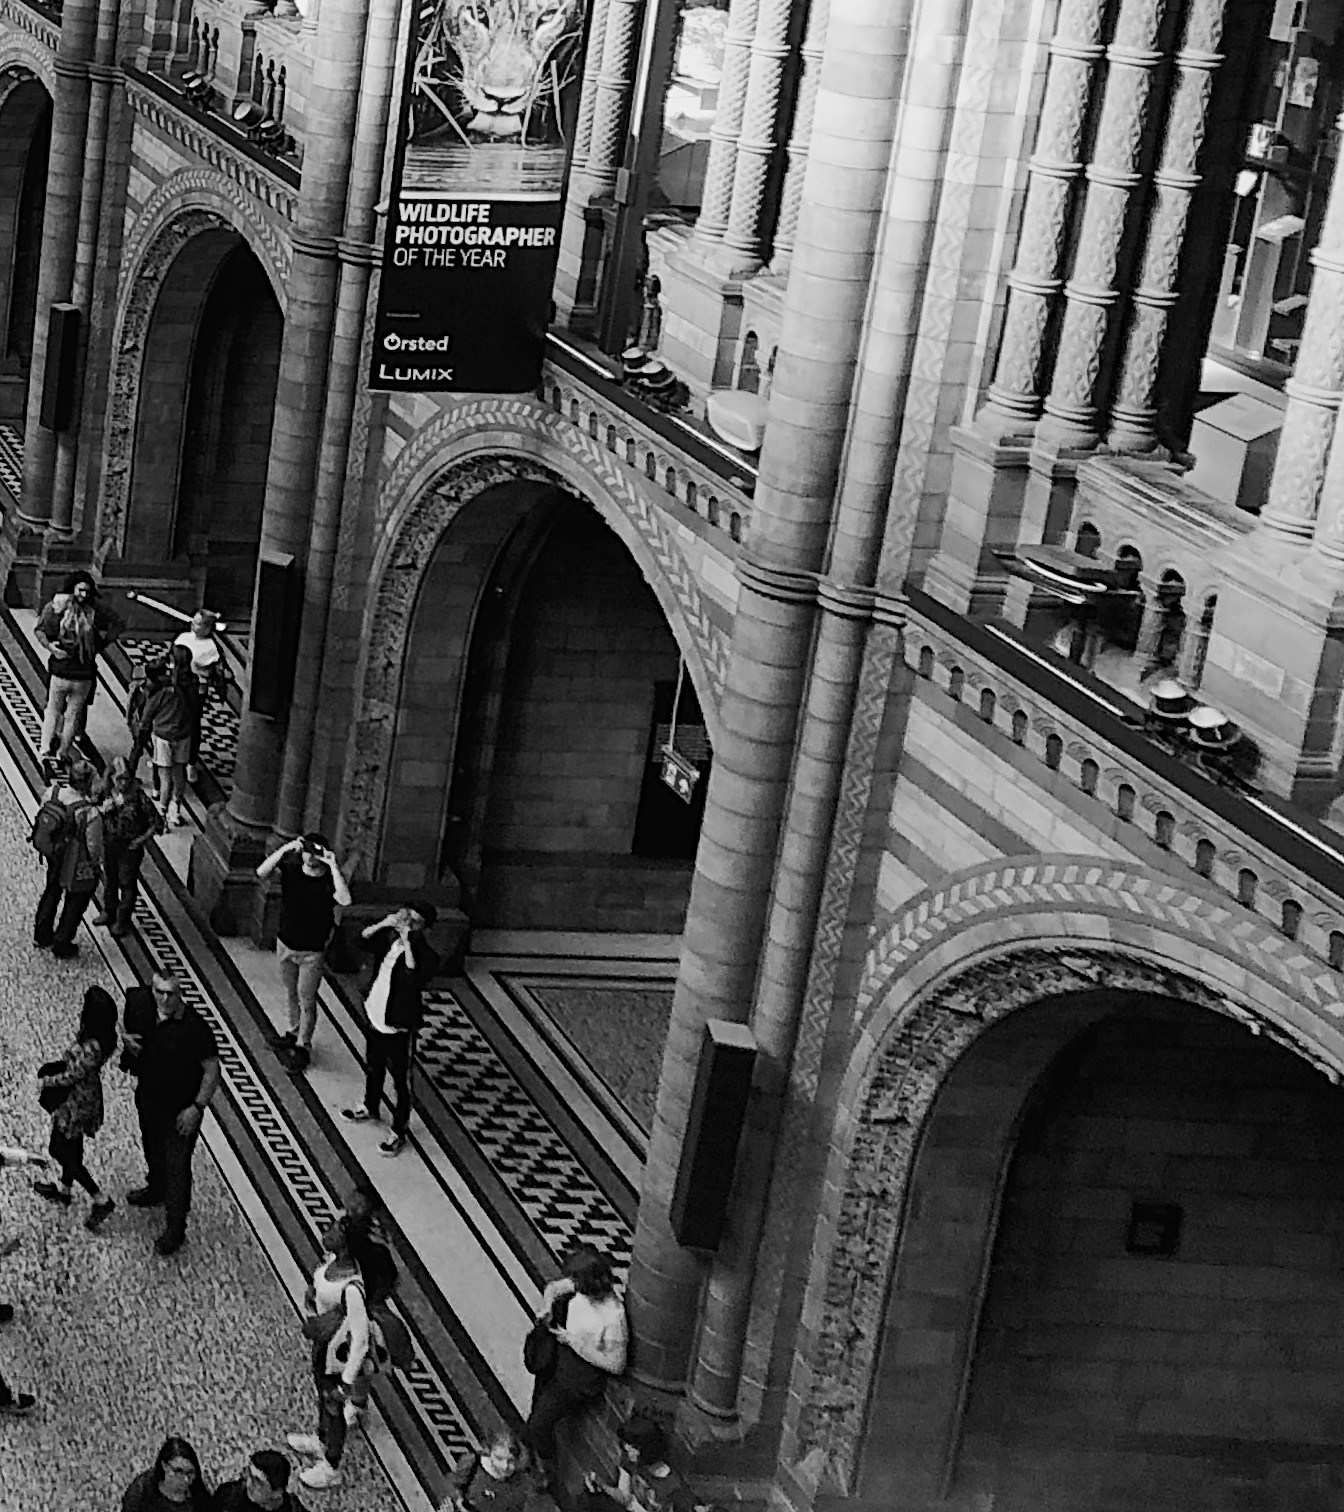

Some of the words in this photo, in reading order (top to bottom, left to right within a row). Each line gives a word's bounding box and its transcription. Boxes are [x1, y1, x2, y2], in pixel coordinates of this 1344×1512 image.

[398, 203, 491, 223] WILDLIFE
[395, 225, 556, 247] PHOTOGRAPHER
[393, 247, 419, 266] OF
[422, 248, 457, 267] THE
[460, 248, 507, 268] YEAR
[379, 363, 453, 380] LUMIX
